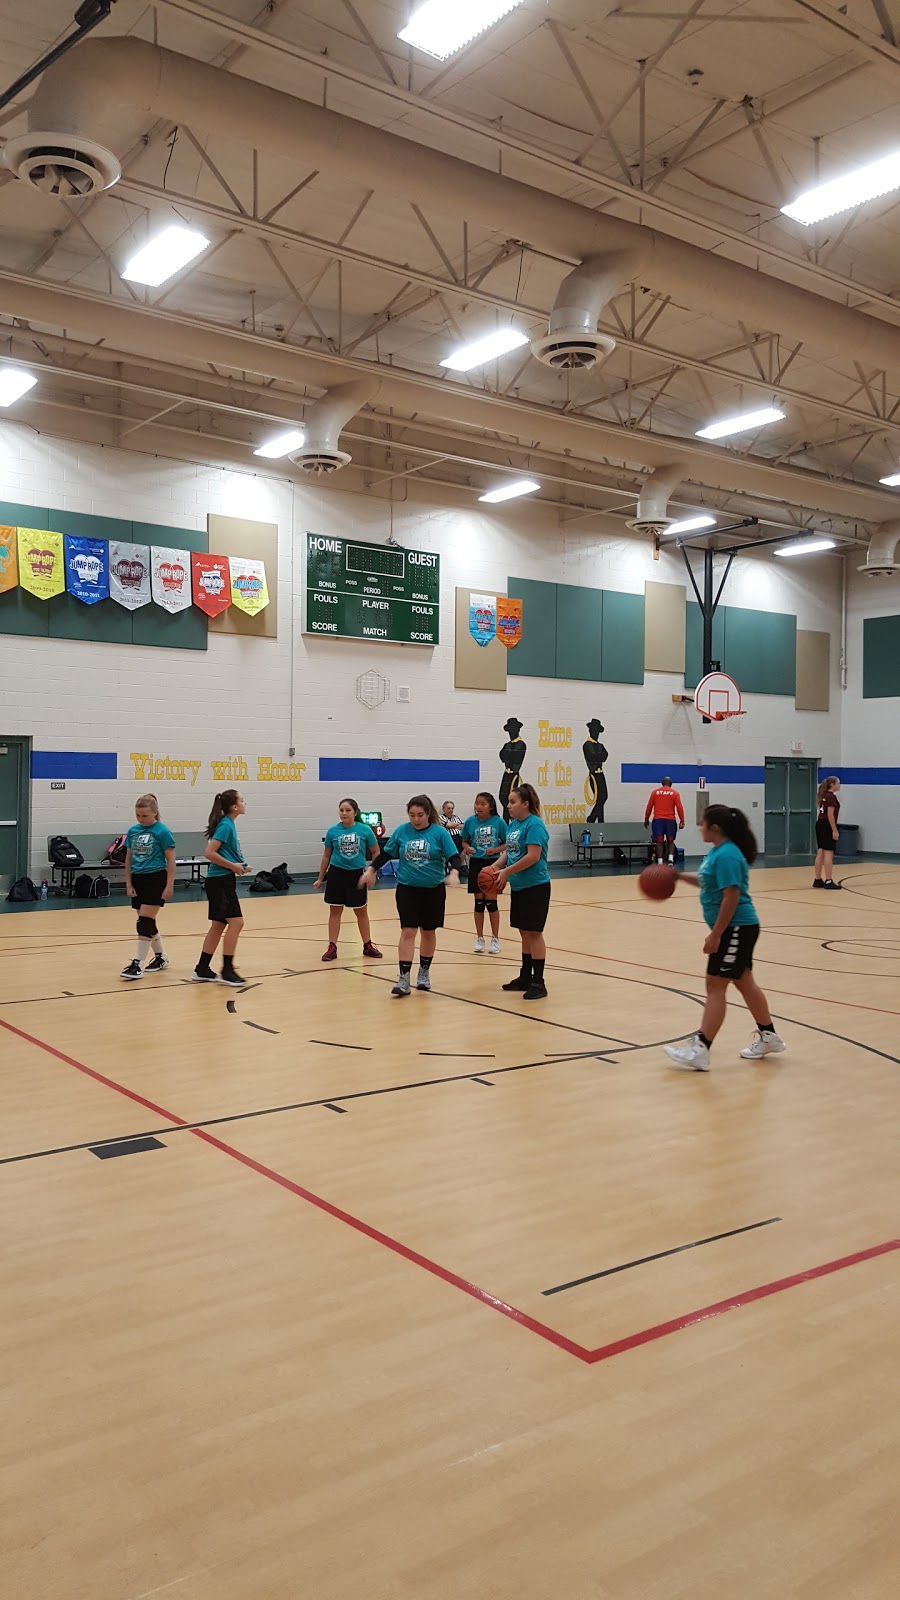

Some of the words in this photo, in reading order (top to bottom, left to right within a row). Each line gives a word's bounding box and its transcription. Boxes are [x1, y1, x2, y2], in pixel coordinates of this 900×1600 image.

[309, 536, 343, 553] HOME
[69, 558, 87, 571] JUMP
[88, 561, 105, 573] ROPE
[407, 552, 438, 567] GUEST
[112, 564, 130, 577] JUMP
[130, 566, 148, 578] ROPE
[154, 567, 171, 579] JUMP
[172, 569, 189, 581] ROPE
[318, 580, 337, 589] BONUS
[363, 586, 382, 595] PERIOD
[313, 593, 339, 604] FOULS
[411, 592, 429, 601] BONUS
[362, 599, 390, 610] PLAYER
[411, 605, 434, 615] FOULS
[311, 621, 338, 632] SCORE
[363, 627, 387, 636] MATCH
[410, 631, 434, 641] SCORE
[538, 719, 572, 748] Home
[130, 753, 202, 787] Victory
[211, 756, 249, 781] with
[257, 757, 307, 781] Honor
[554, 760, 572, 787] the
[540, 798, 587, 825] vericks
